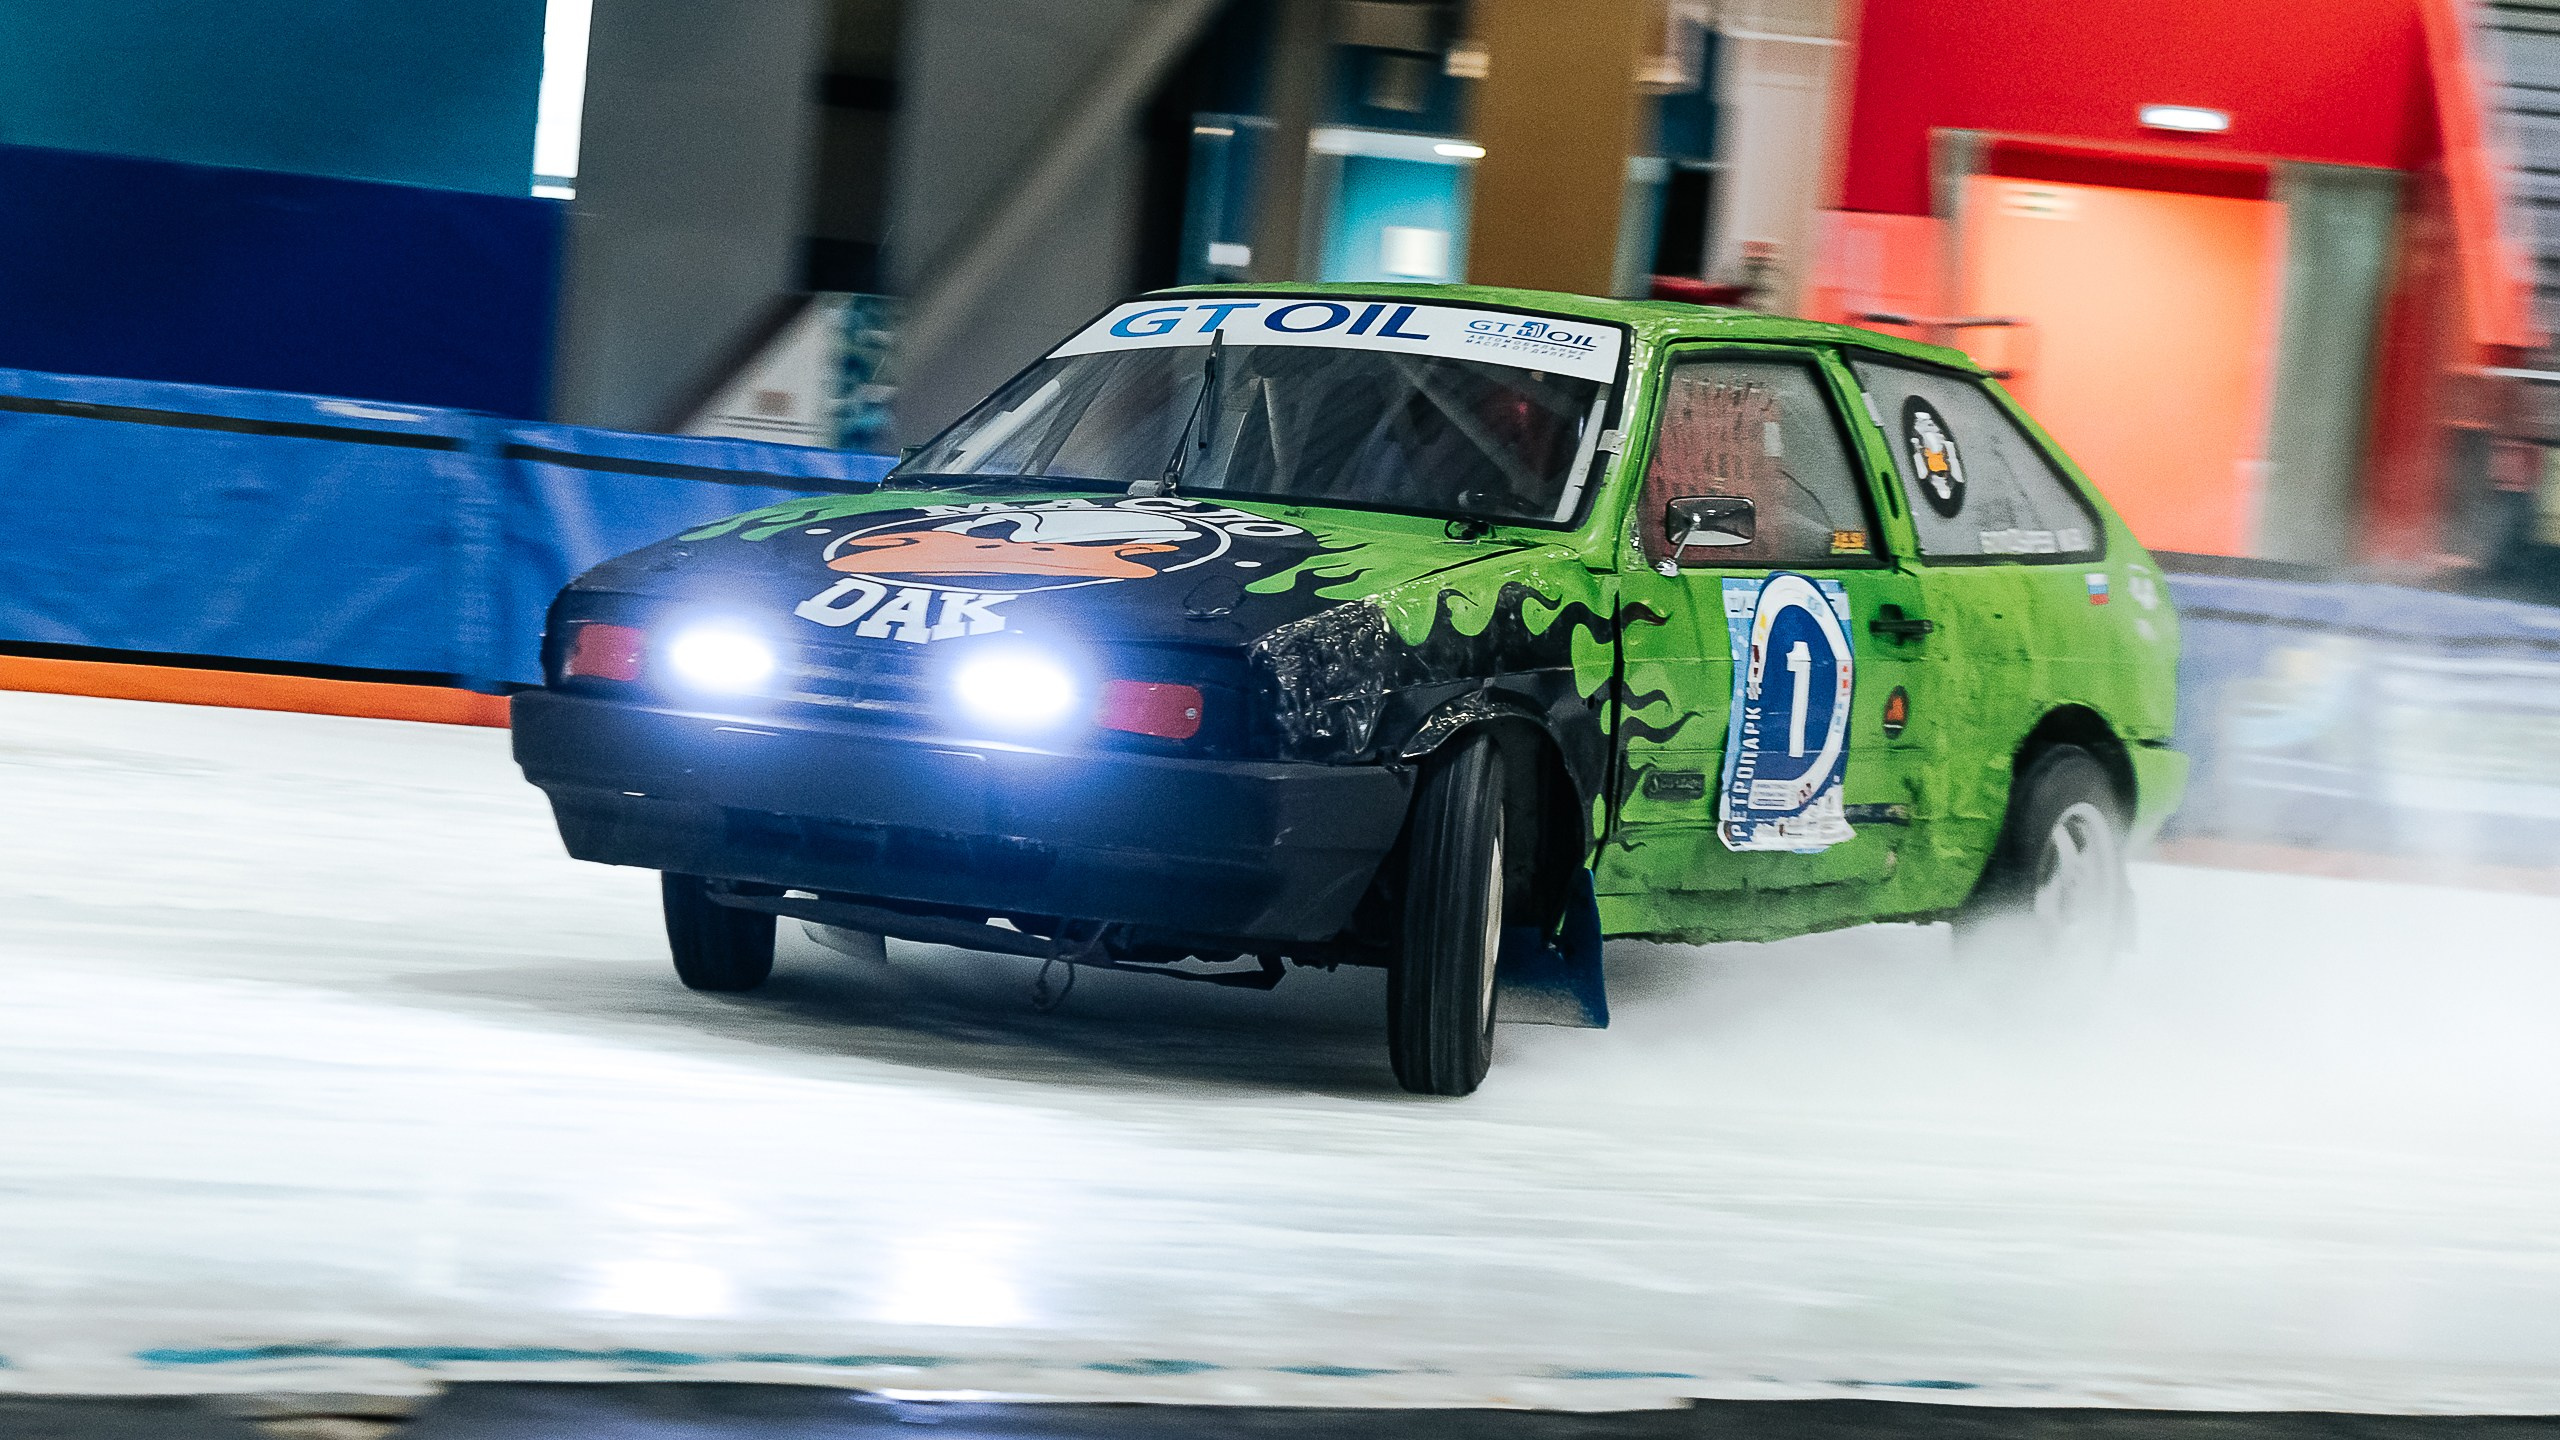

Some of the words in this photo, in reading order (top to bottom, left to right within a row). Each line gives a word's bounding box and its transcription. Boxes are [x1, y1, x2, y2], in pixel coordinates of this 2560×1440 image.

[1110, 303, 1260, 337] GT
[1264, 303, 1430, 340] OIL
[1469, 320, 1516, 333] GT
[1547, 331, 1597, 348] OIL
[1465, 339, 1507, 348] МАСЛА
[1468, 335, 1587, 356] АВТОМОБИЛЬНЫЕ
[794, 578, 1019, 645] DAK
[1786, 641, 1812, 757] 1
[1730, 707, 1762, 838] РЕТРОПАРК
